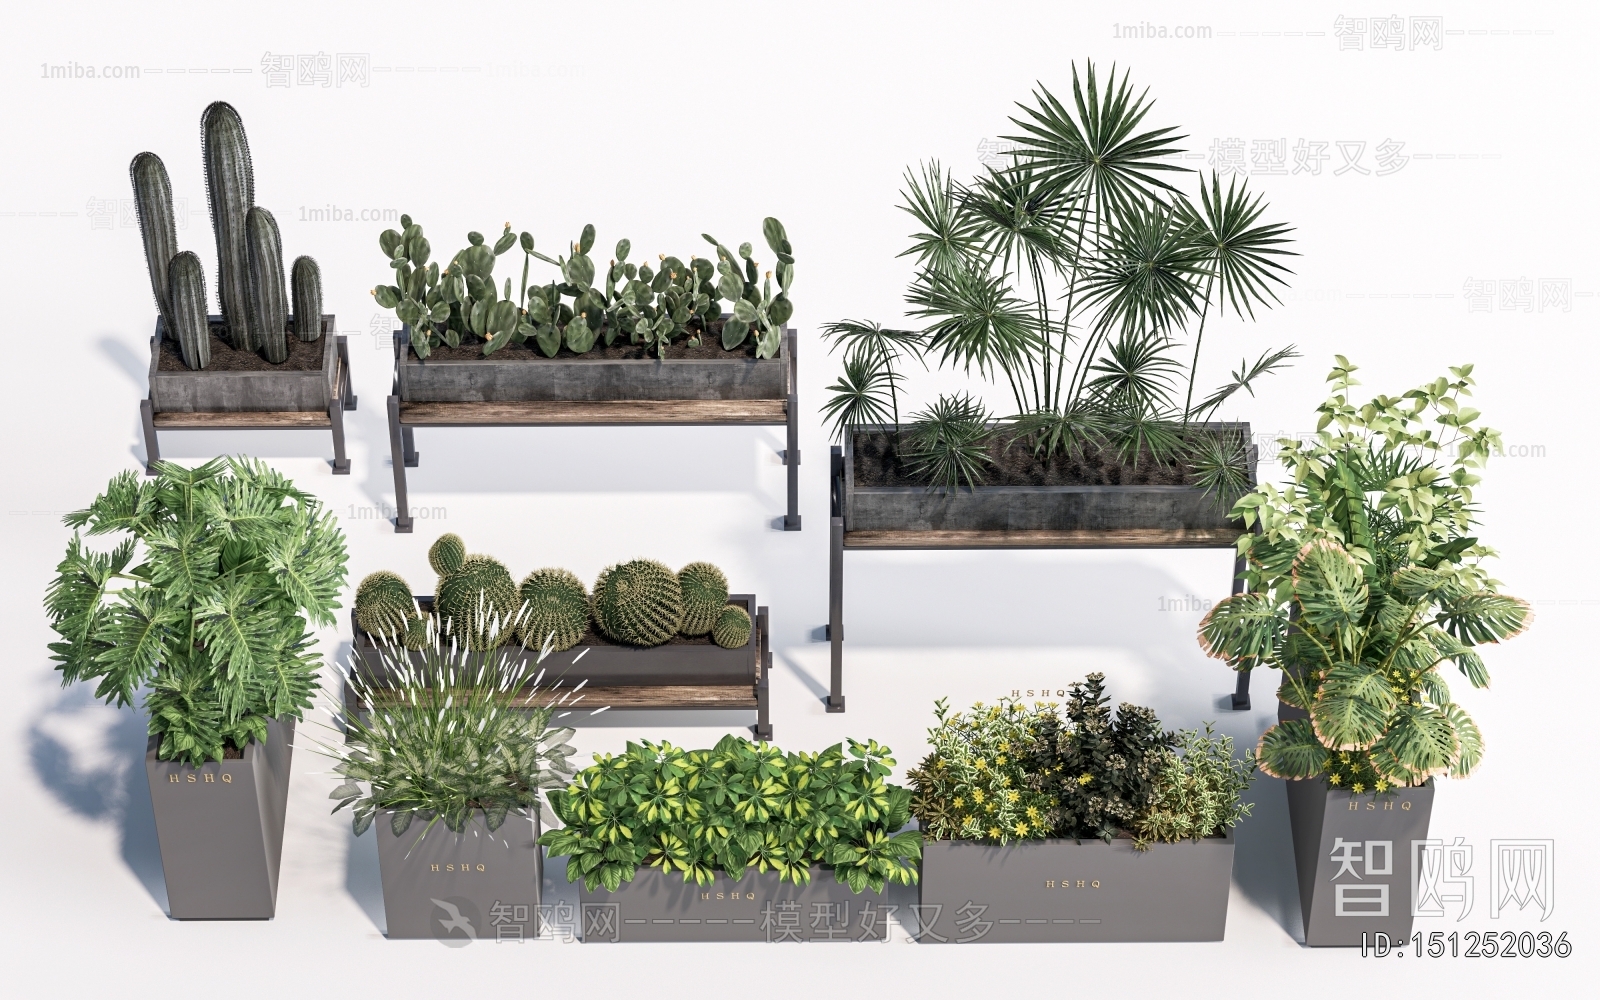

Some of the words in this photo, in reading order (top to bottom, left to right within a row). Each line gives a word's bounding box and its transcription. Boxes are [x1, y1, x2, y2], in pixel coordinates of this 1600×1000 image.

[169, 773, 232, 784] HSHQ
[1348, 801, 1412, 811] HSHQ
[430, 863, 486, 872] HSHQ
[1046, 880, 1100, 888] HSHQ
[701, 892, 755, 900] HSHQ
